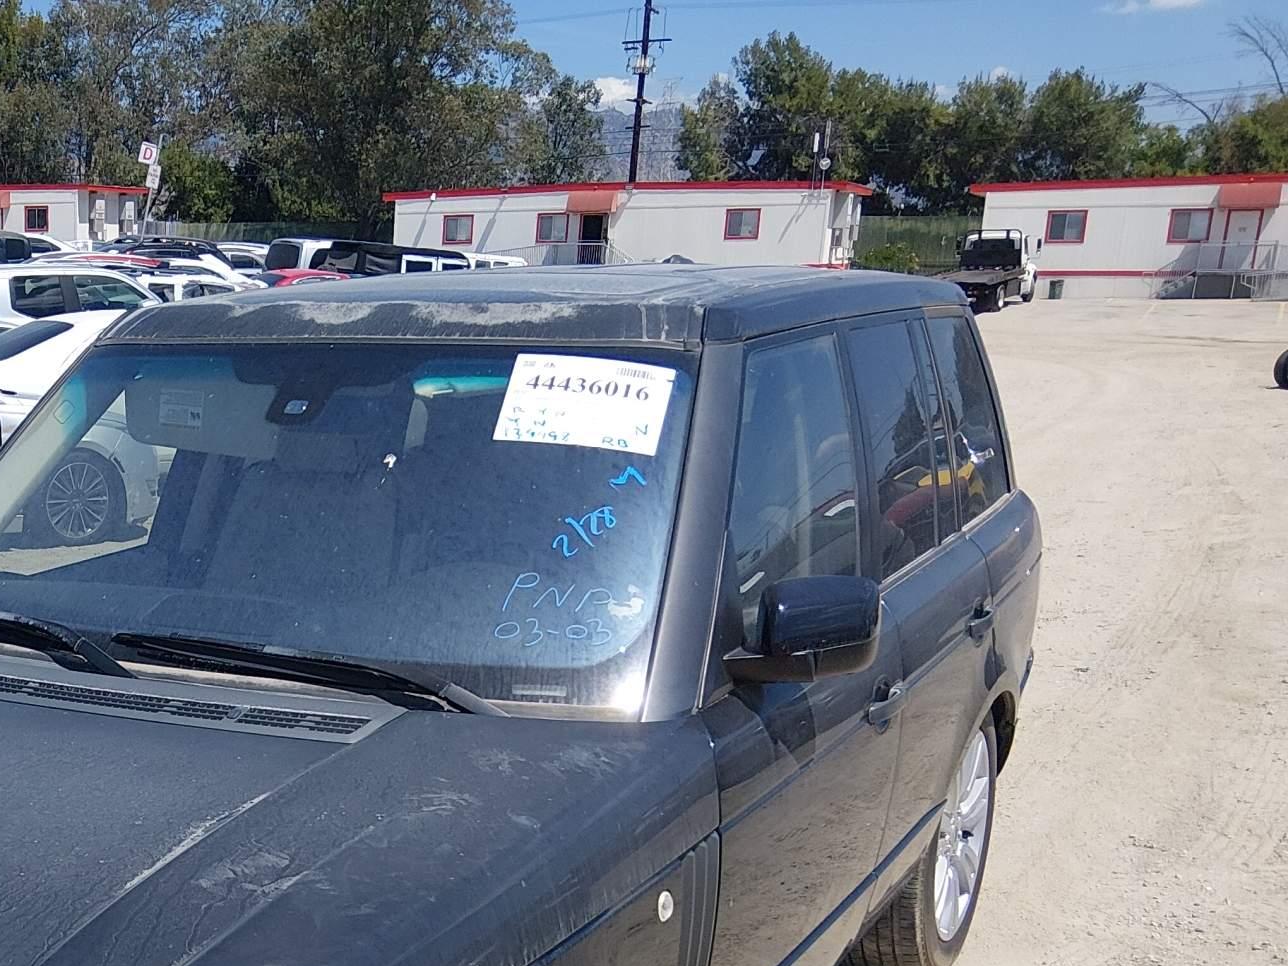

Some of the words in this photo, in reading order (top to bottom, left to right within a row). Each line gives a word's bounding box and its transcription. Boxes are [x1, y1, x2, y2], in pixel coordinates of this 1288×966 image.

[143, 147, 153, 160] D
[526, 374, 650, 401] 44436016
[494, 618, 612, 647] 03-03
